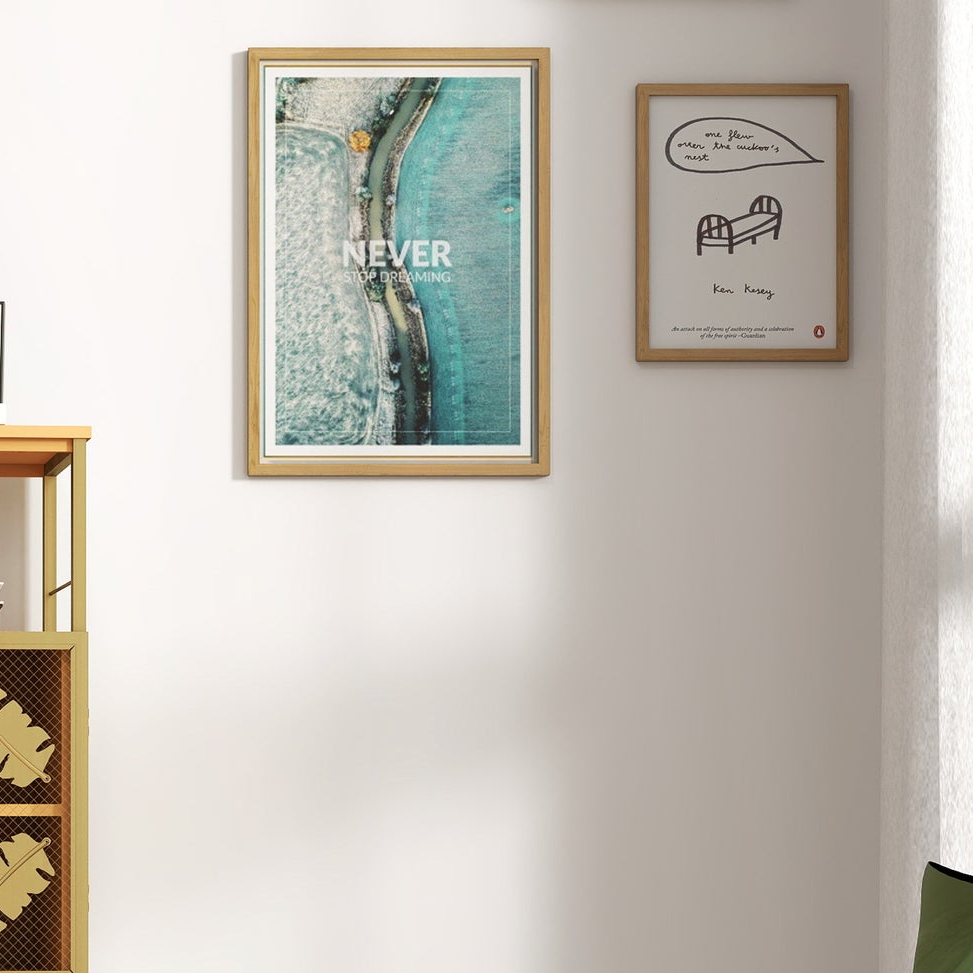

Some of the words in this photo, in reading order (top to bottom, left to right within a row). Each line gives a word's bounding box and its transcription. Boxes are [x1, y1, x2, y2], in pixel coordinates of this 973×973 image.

[727, 129, 754, 142] flew
[677, 141, 705, 150] over
[712, 141, 731, 151] the
[684, 153, 710, 162] nest
[342, 239, 453, 268] NEVER
[343, 271, 377, 283] STOP
[380, 271, 451, 283] DREAMING
[713, 283, 734, 294] Ken
